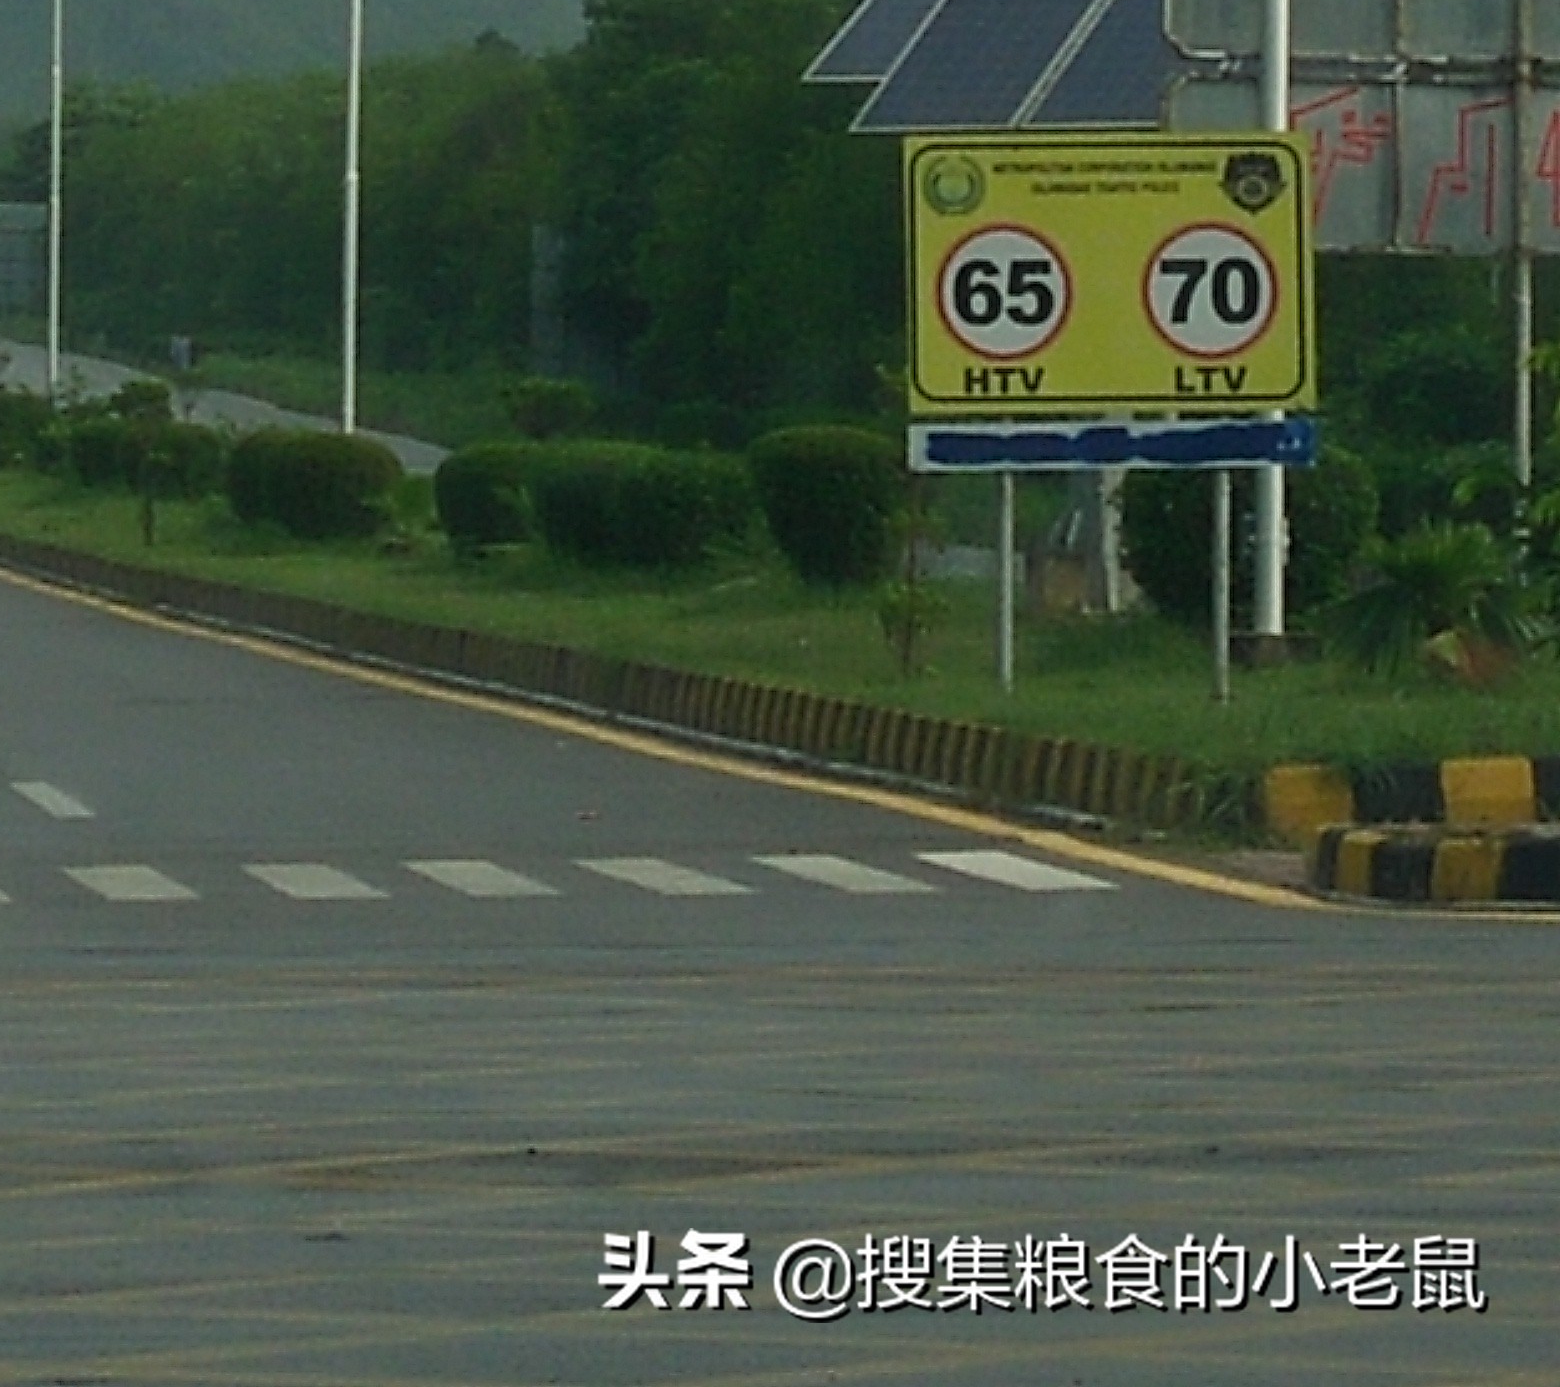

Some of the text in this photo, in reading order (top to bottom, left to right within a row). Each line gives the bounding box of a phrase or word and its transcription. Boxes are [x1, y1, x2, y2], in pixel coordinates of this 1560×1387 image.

[953, 258, 1055, 326] 65
[1158, 257, 1261, 326] 70
[963, 367, 1045, 395] HTV
[1173, 366, 1248, 395] LTV
